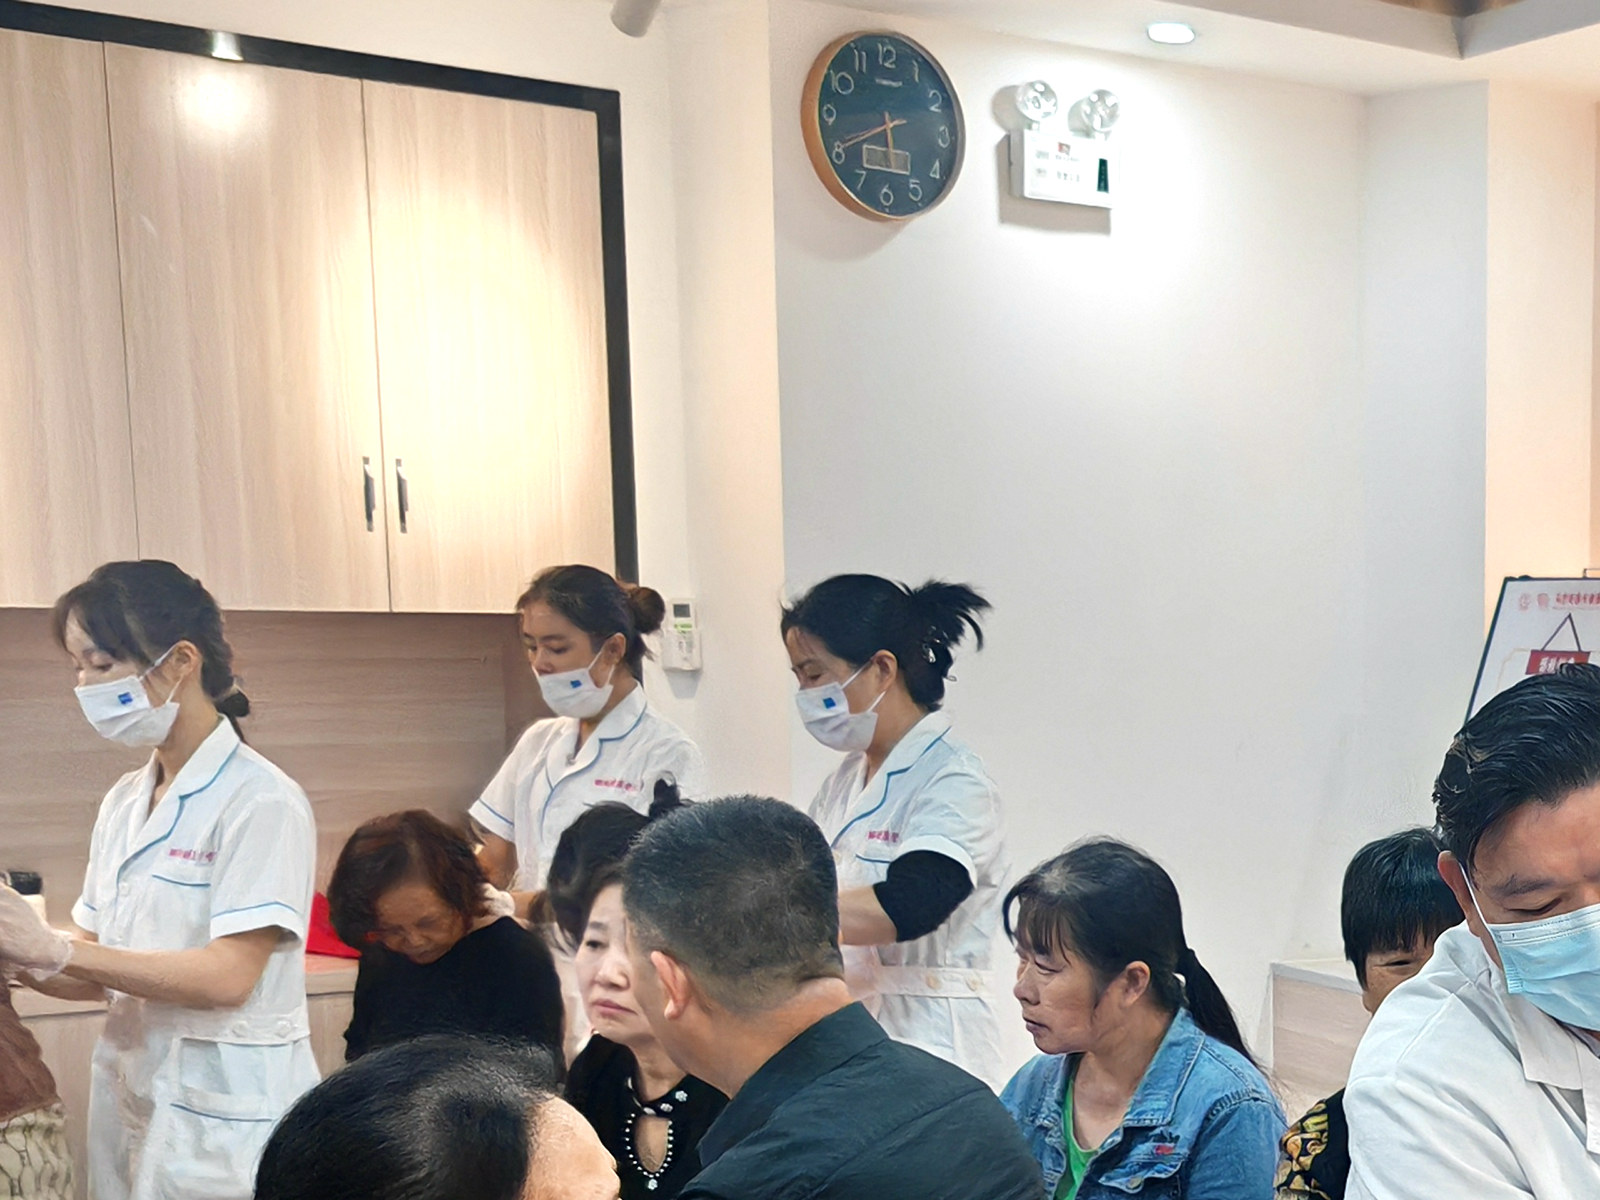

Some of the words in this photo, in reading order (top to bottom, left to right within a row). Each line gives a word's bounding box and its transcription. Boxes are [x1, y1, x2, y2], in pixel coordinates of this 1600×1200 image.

[853, 47, 867, 73] 11
[877, 43, 896, 68] 12
[830, 69, 855, 95] 10
[928, 89, 942, 112] 2
[822, 103, 837, 126] 9
[832, 141, 846, 165] 8
[855, 169, 867, 190] 7
[929, 159, 940, 179] 4
[879, 184, 894, 206] 6
[908, 179, 923, 201] 5
